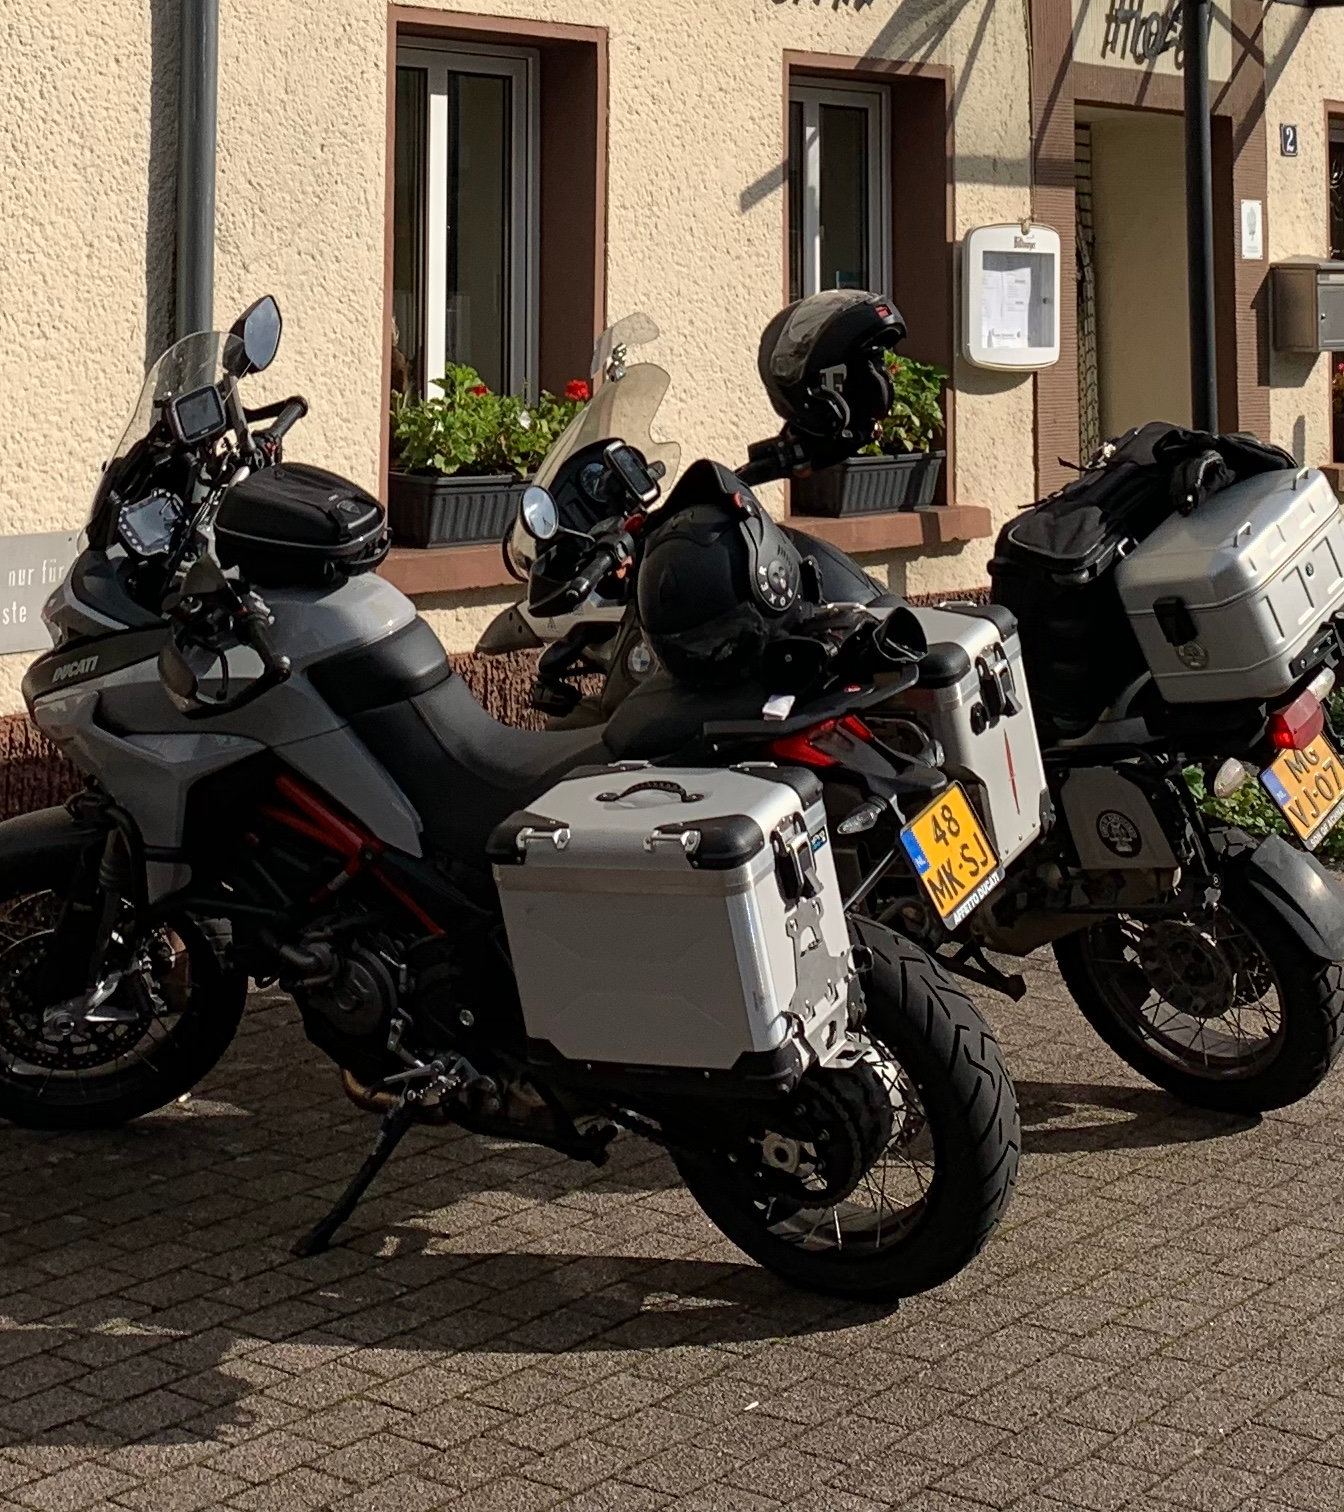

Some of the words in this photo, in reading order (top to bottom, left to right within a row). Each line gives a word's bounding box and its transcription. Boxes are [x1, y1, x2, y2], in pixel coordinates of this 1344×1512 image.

[1285, 126, 1295, 153] 2
[9, 568, 34, 587] nur
[42, 559, 64, 584] für
[52, 655, 99, 683] DUCATI
[1284, 747, 1320, 783] MG
[931, 804, 960, 847] 48
[977, 871, 1000, 902] DUCATI
